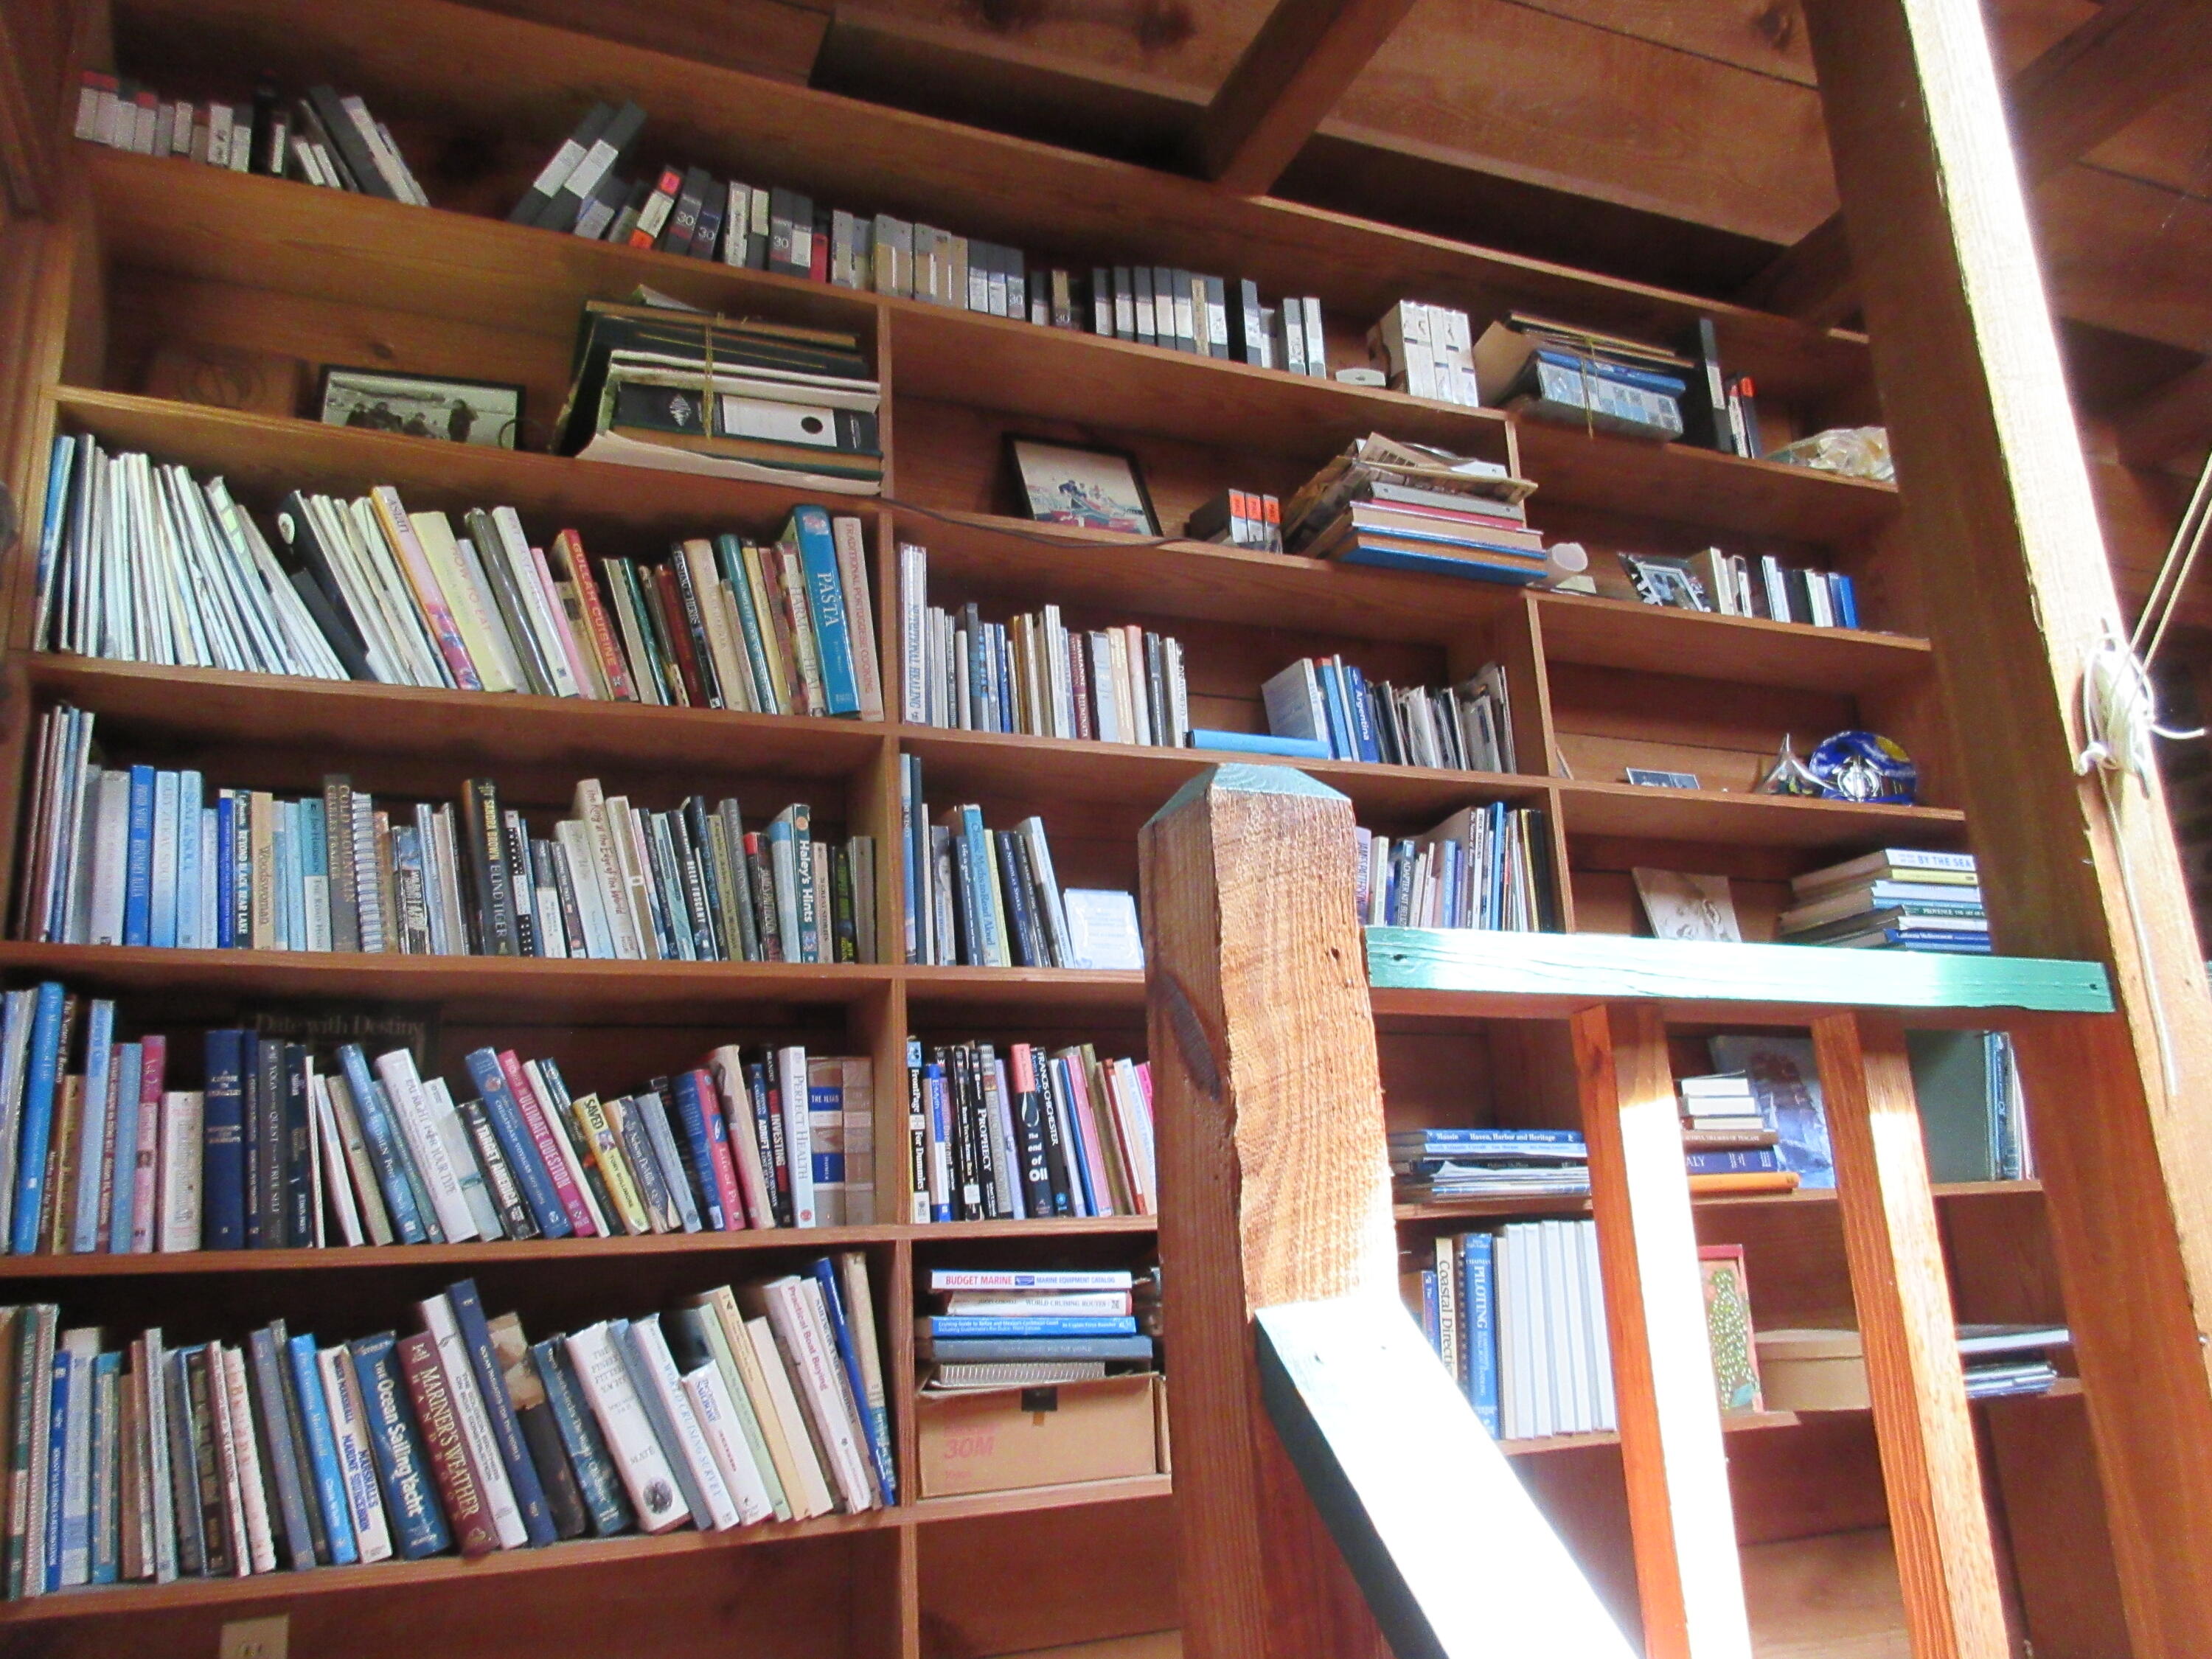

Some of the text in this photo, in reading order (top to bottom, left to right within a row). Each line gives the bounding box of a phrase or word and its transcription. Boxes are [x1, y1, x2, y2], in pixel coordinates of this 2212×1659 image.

[677, 212, 695, 226] 30
[698, 228, 715, 243] 30
[773, 235, 790, 250] 30
[449, 545, 470, 580] HOW
[465, 585, 480, 605] TO
[474, 606, 493, 633] EAT
[571, 541, 616, 667] GULLAH CUISINE
[816, 570, 840, 627] PASTA
[845, 522, 874, 694] TRADITIONAL PORTUGUESE COOKING
[908, 602, 920, 708] NUTRITIONAL HEALING
[1354, 688, 1370, 741] Argentina
[338, 784, 350, 823] COLD
[484, 799, 498, 860] SANDRA BROWN
[960, 844, 968, 857] Life
[969, 822, 982, 852] Classic
[237, 863, 247, 888] BLACK
[589, 803, 603, 823] King
[599, 846, 614, 867] Edge
[611, 888, 625, 915] World
[798, 839, 813, 922] Haley's Hints
[972, 854, 988, 884] Myths
[1402, 860, 1411, 892] ADAPTER
[1918, 855, 1931, 865] BY
[1933, 856, 1950, 866] THE
[1952, 857, 1972, 868] SEA
[259, 844, 270, 924] Woodswoman
[490, 863, 505, 938] BLIND TIGER
[685, 859, 706, 924] BELLA TUSCANY
[1006, 850, 1023, 912] NICHOLAS SPARKS
[1401, 894, 1409, 904] KIT
[238, 912, 248, 933] LAKE
[980, 893, 991, 917] Read
[982, 918, 997, 946] Aloud
[306, 1015, 349, 1035] with
[353, 1015, 425, 1037] Destiny
[911, 1068, 920, 1113] FrontPage
[931, 1079, 941, 1110] E-Myth
[1036, 1051, 1058, 1146] FRANCIS CHICHESTER
[582, 1097, 605, 1131] SAVED
[757, 1118, 769, 1150] ADRIFT
[792, 1074, 809, 1180] PERFECT HEALTH
[518, 1093, 570, 1189] ULTIMATE QUESTION
[770, 1113, 785, 1166] INVESTING
[976, 1107, 991, 1172] PROPHECY
[1027, 1143, 1043, 1152] end
[1028, 1132, 1039, 1140] The
[1493, 1133, 1516, 1141] Harbor
[1528, 1133, 1556, 1142] Heritage
[475, 1122, 519, 1209] TARGET AMERICA
[914, 1131, 925, 1190] For Dummies
[1029, 1169, 1048, 1183] Oil
[1031, 1155, 1043, 1167] of
[439, 1172, 457, 1196] TYPE
[945, 1275, 1013, 1287] BUDGET MARINE
[1036, 1276, 1116, 1284] MARINE EQUIPMENT CATALOG
[1438, 1259, 1453, 1312] Coastal
[1472, 1265, 1488, 1329] PILOTING
[1026, 1298, 1107, 1308] WORLD CRUISING ROUTES
[479, 1344, 492, 1370] OCEAN
[787, 1284, 830, 1392] Practical Boat Buying
[336, 1380, 355, 1423] MARSHALL
[694, 1379, 717, 1424] SAILBOAT
[373, 1360, 426, 1518] THE Ocean Sailing Yacht
[418, 1365, 481, 1520] MARINER'S WEATHER
[459, 1390, 473, 1415] BOAT
[467, 1415, 494, 1481] CONSTRUCTION
[661, 1361, 723, 1498] WORLD CRUISING SURVEY
[340, 1433, 358, 1472] MARINE
